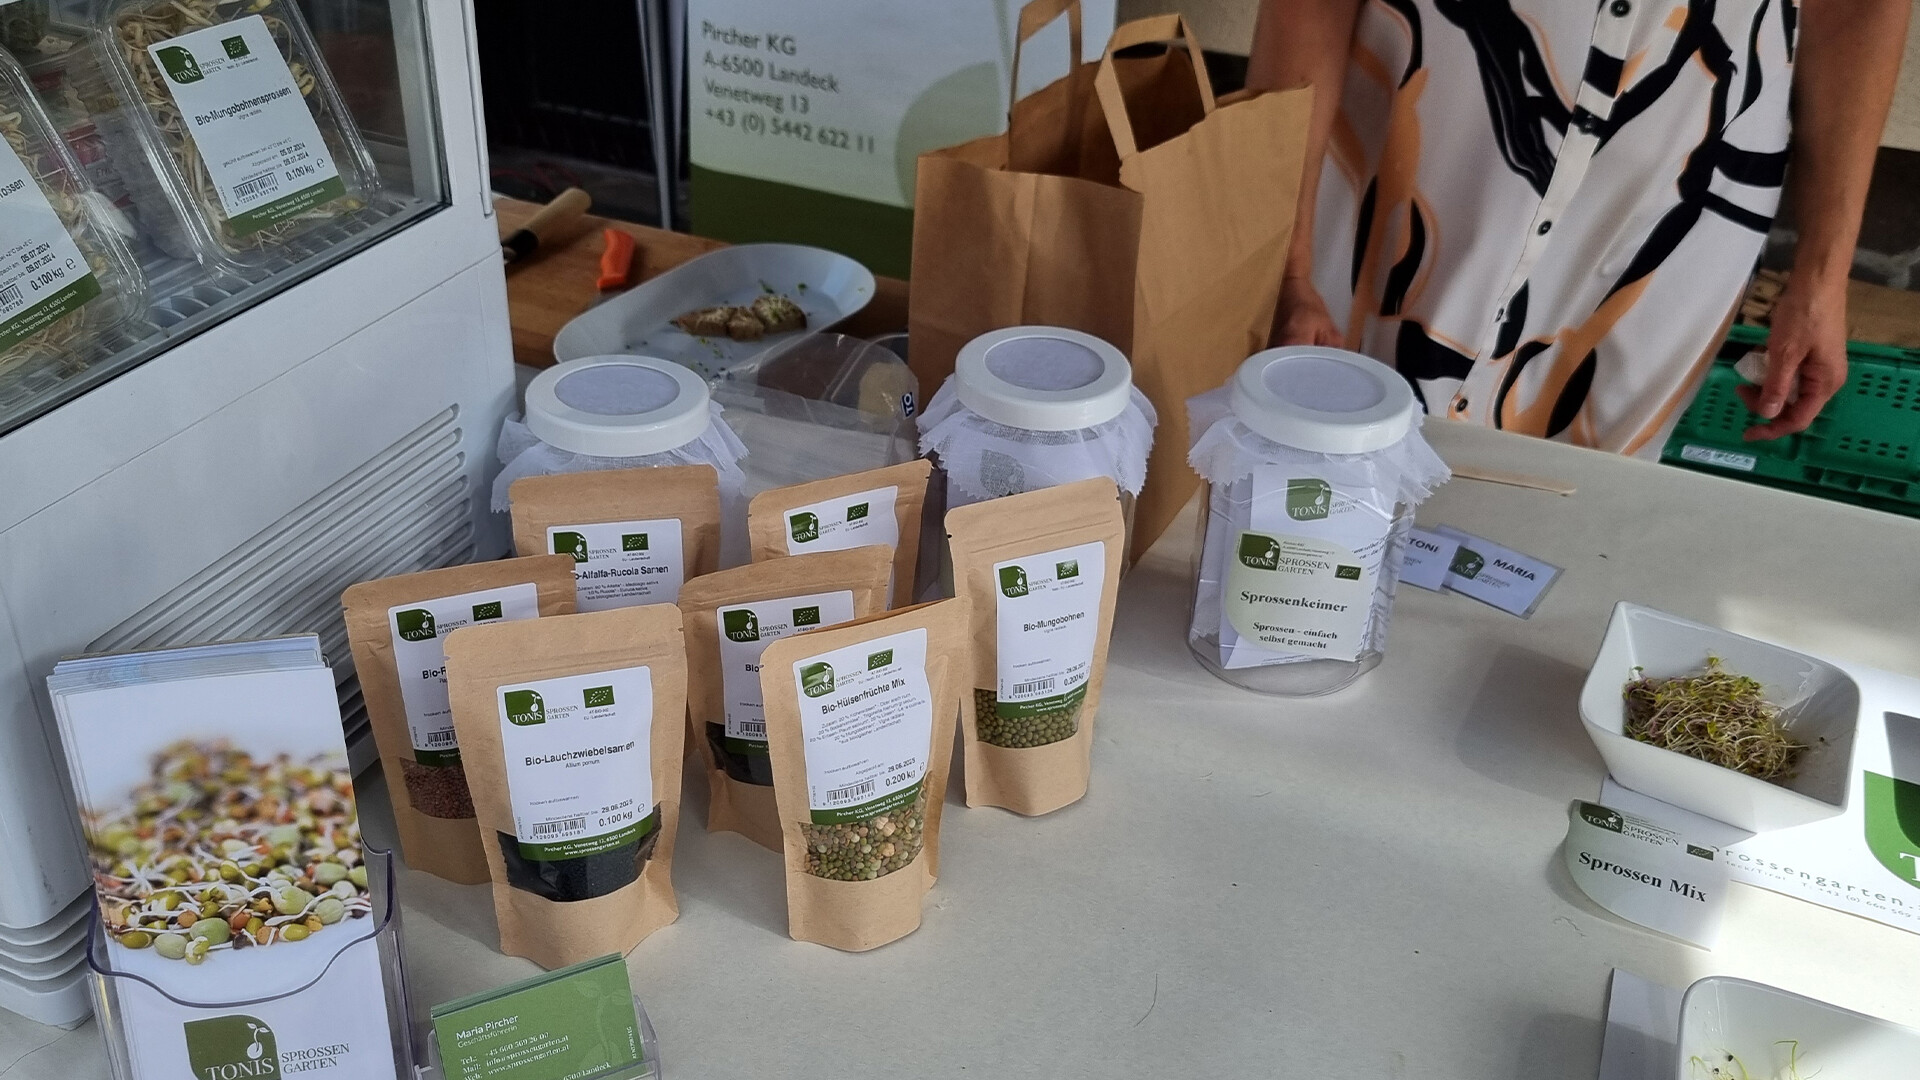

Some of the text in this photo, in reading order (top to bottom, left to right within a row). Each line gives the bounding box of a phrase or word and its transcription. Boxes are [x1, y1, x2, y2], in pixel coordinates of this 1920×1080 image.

[702, 20, 797, 56] Pircher KG
[174, 67, 200, 82] TONIS
[703, 50, 839, 94] A-6500 Landeck
[703, 76, 810, 114] Venetweg 13
[194, 86, 292, 126] Bio-Mungobohnensprossen
[705, 108, 875, 153] +43 (0) 5442 622 11
[285, 163, 315, 181] 0.100 kg
[30, 267, 65, 291] 0.100 kg
[1292, 504, 1327, 517] TONIS
[795, 530, 817, 541] TONIS
[1409, 537, 1439, 553] TONI
[1244, 555, 1275, 567] TONIS
[1279, 557, 1330, 570] SPROSSEN
[640, 565, 669, 576] Samen
[1278, 565, 1314, 576] GARTEN
[1493, 559, 1536, 581] MARIA
[1005, 584, 1027, 596] TONIS
[1240, 590, 1348, 612] Sprossenkeimer
[437, 619, 468, 630] SPROSSEN
[760, 624, 788, 632] SPROSSEN
[1023, 611, 1085, 633] Bio-Mungobohnen
[1253, 622, 1338, 639] Sprossen einfach
[405, 629, 434, 640] TONIS
[731, 631, 757, 640] TONIS
[1259, 635, 1327, 649] selbst gemacht
[807, 681, 833, 696] TONIS
[822, 678, 906, 715] Bio-Hülsenfrüchte Mix
[513, 711, 543, 723] TONIS
[546, 704, 579, 714] SPROSSEN
[525, 740, 635, 766] Bio-Lauchzwiebelsamen
[885, 769, 916, 787] 0.200 kg
[599, 810, 633, 827] 0.100 kg
[1586, 814, 1619, 830] TONIS
[1623, 824, 1680, 846] SPROSSEN
[1623, 830, 1663, 846] GARTEN
[1578, 851, 1707, 902] Sprossen Mix
[456, 1015, 518, 1040] Maria Pircher
[457, 1025, 518, 1048] Geschäftsführerin
[281, 1043, 350, 1063] SPROSSEN
[205, 1057, 275, 1080] TONIS
[283, 1056, 338, 1074] GARTEN
[462, 1063, 482, 1075] Mail:
